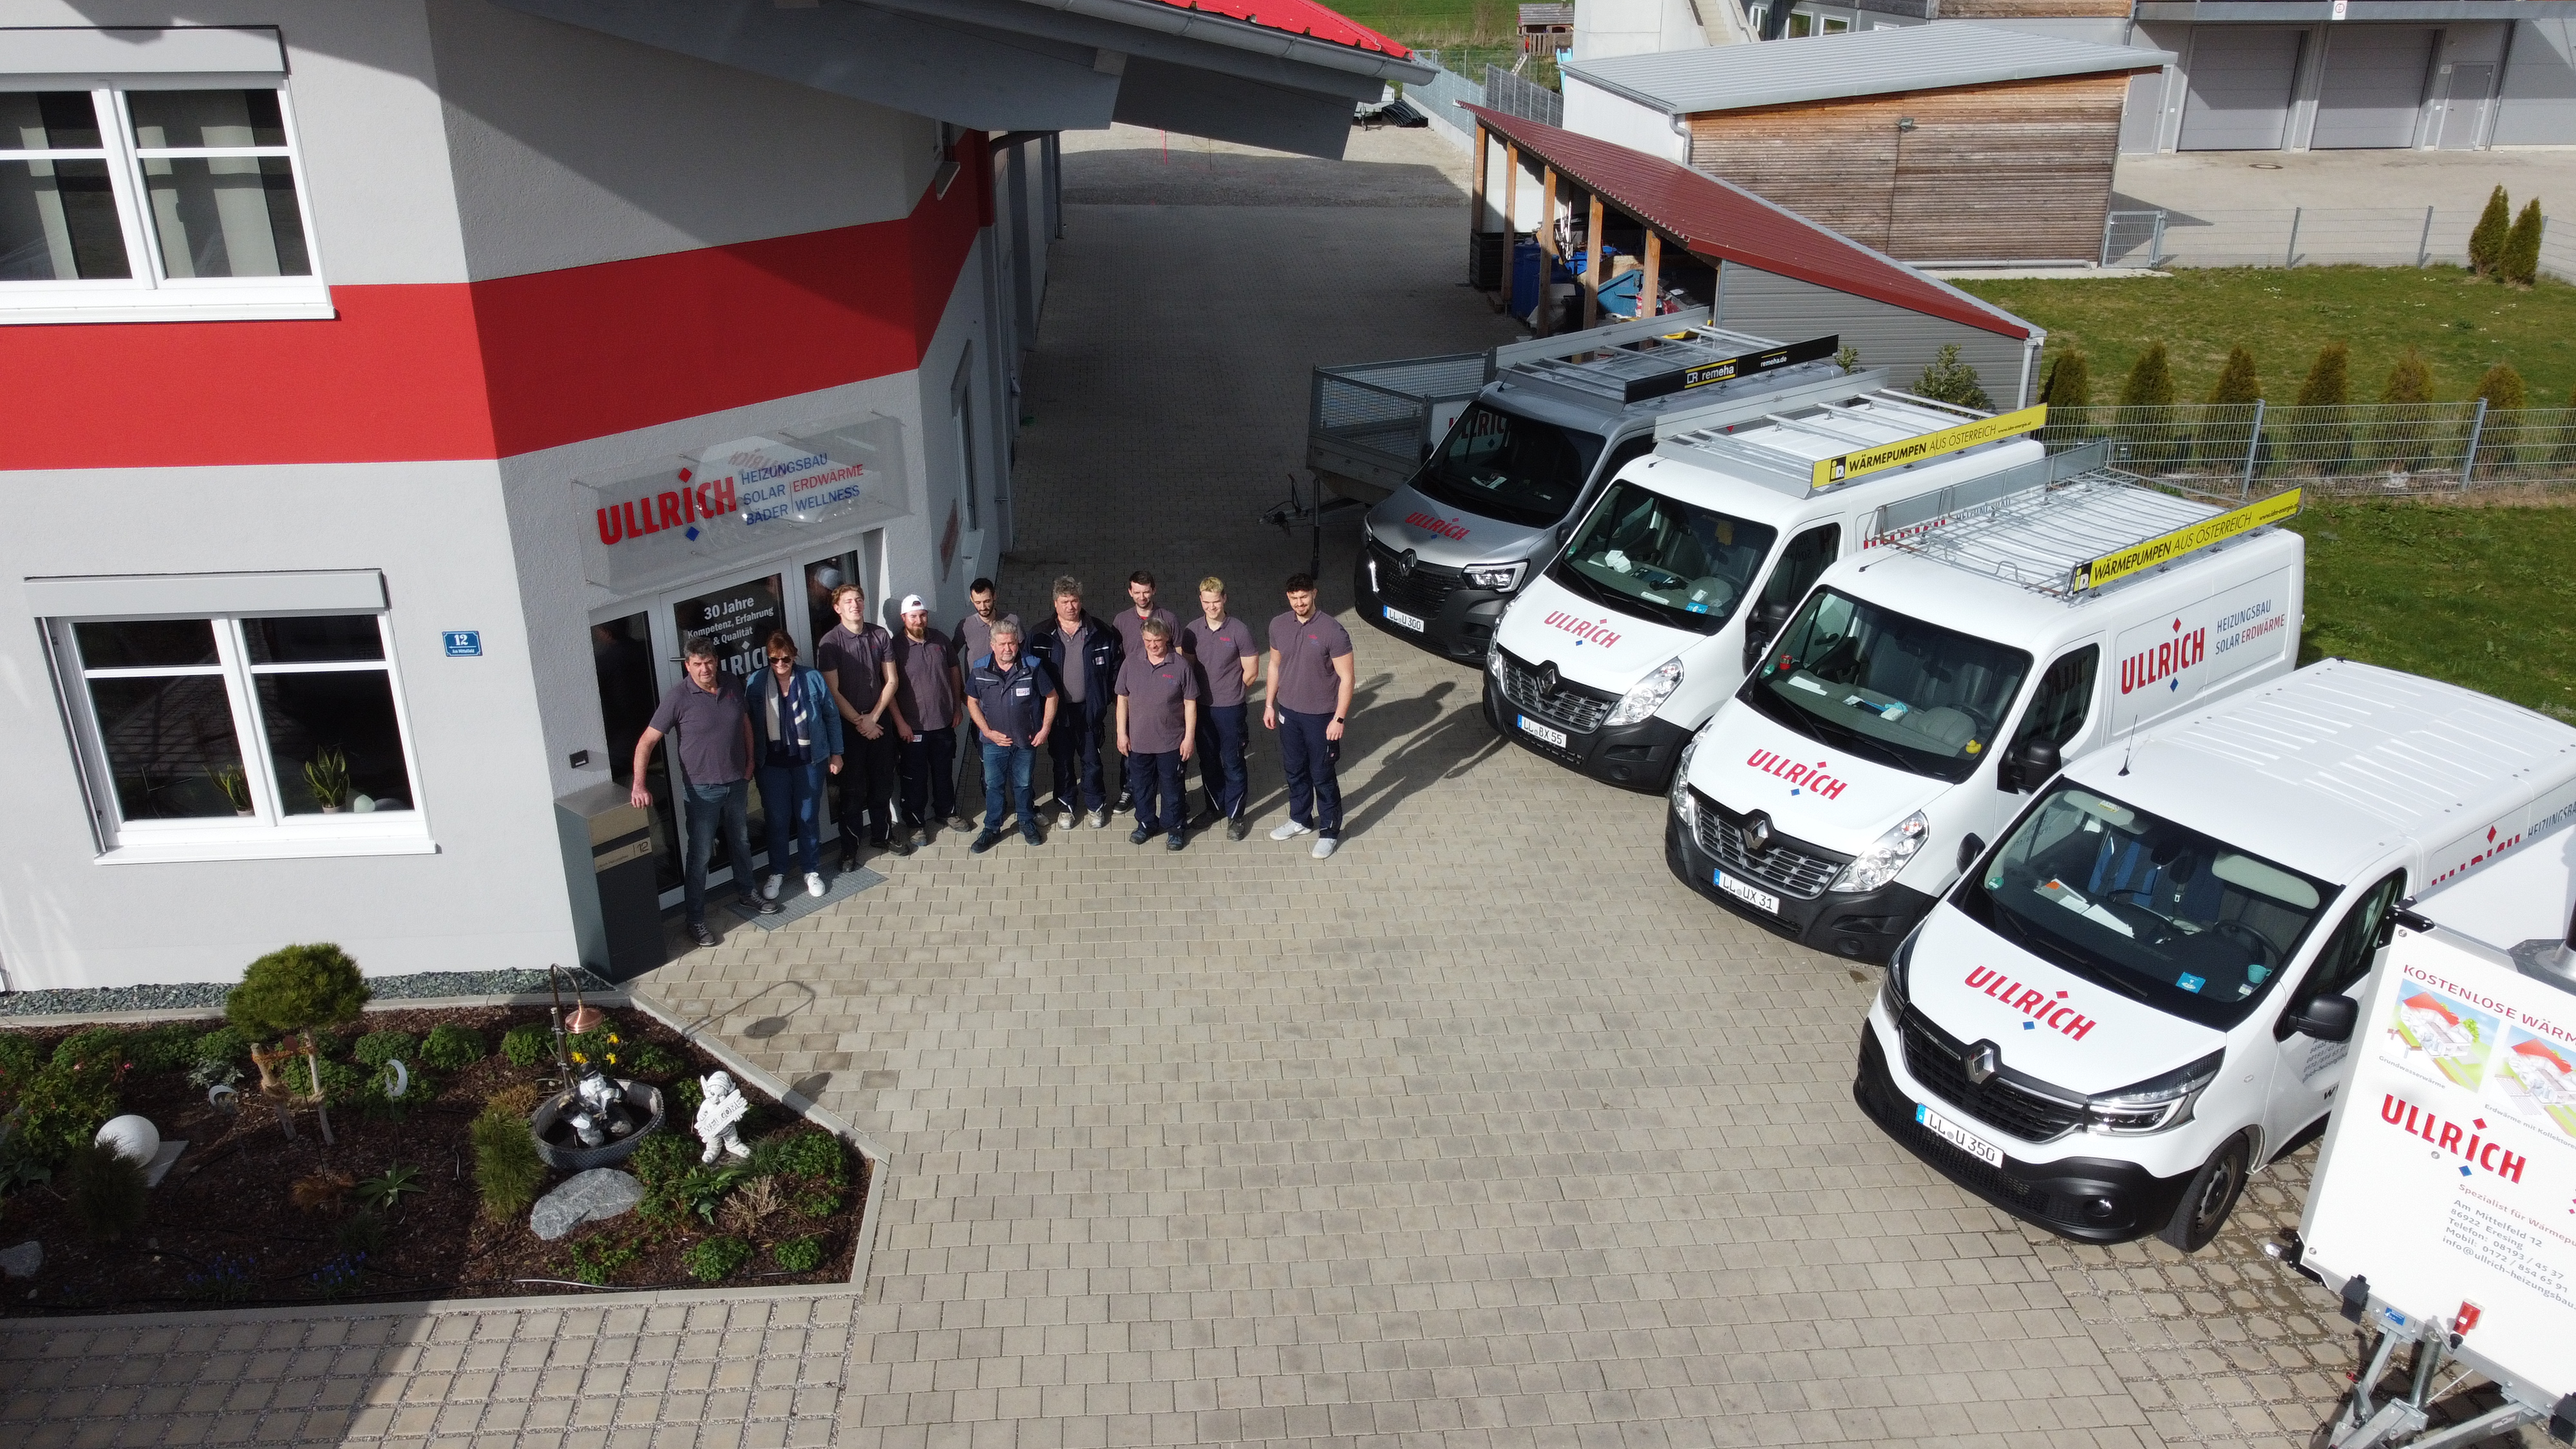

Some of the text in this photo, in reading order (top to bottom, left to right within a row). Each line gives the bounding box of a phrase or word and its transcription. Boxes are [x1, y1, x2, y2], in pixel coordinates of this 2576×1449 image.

[1702, 365, 1734, 381] remeha
[1849, 442, 1927, 472] WÄRMEPUMPEN
[1929, 437, 1947, 451] AUS
[1949, 424, 1996, 446] ÖSTERREICH
[741, 453, 828, 485] HEIZUNGSBAU
[743, 464, 864, 506] SOLAR ERDWÄRME
[597, 468, 737, 545] ULLRICH
[746, 485, 860, 526] BÄDER WELLNESS
[1405, 511, 1470, 541] ULLRICH
[2094, 540, 2172, 582] WÄRMEPUMPEN
[2173, 533, 2194, 553] AUS
[2196, 511, 2253, 544] ÖSTERREICH
[687, 607, 774, 639] Kompetenz, Erfahrung
[704, 597, 754, 620] 30 Jahre
[2217, 600, 2271, 634] HEIZUNGSBAU
[454, 634, 468, 646] 12
[713, 626, 753, 646] & Qualität
[1544, 611, 1622, 649] ULLRICH
[2215, 614, 2285, 655] SOLAR ERDWÄRME
[2121, 617, 2205, 695] ULLRICH
[1524, 719, 1563, 745] LL BX 55
[1747, 748, 1848, 800] ULLRICH
[637, 841, 649, 853] 12
[1723, 876, 1736, 892] LL
[1743, 885, 1757, 902] UX
[1759, 895, 1772, 910] 31
[1964, 965, 2097, 1041] ULLRICH
[2403, 964, 2517, 1019] KOSTENLOSE
[2378, 1056, 2446, 1089] Grundwasserwärme
[704, 1099, 743, 1133] WELCOME
[2485, 1104, 2521, 1124] Erdwärme
[2523, 1122, 2535, 1131] mit
[1929, 1113, 1995, 1162] LL U 350
[2382, 1094, 2526, 1184] ULLRICH
[2459, 1184, 2508, 1213] Spezialist
[2510, 1209, 2526, 1220] für
[2450, 1208, 2524, 1251] 86922 Eresing
[2454, 1200, 2543, 1247] Am Mittelfeld 12
[2446, 1227, 2477, 1247] Mobil:
[2483, 1246, 2508, 1263] 0172
[2518, 1264, 2537, 1278] 854
[2540, 1275, 2552, 1285] 65
[2555, 1283, 2568, 1293] 91
[2448, 1217, 2488, 1242] Telefon:
[2494, 1240, 2524, 1260] 08193
[2535, 1262, 2548, 1272] 45
[2551, 1270, 2564, 1280] 37
